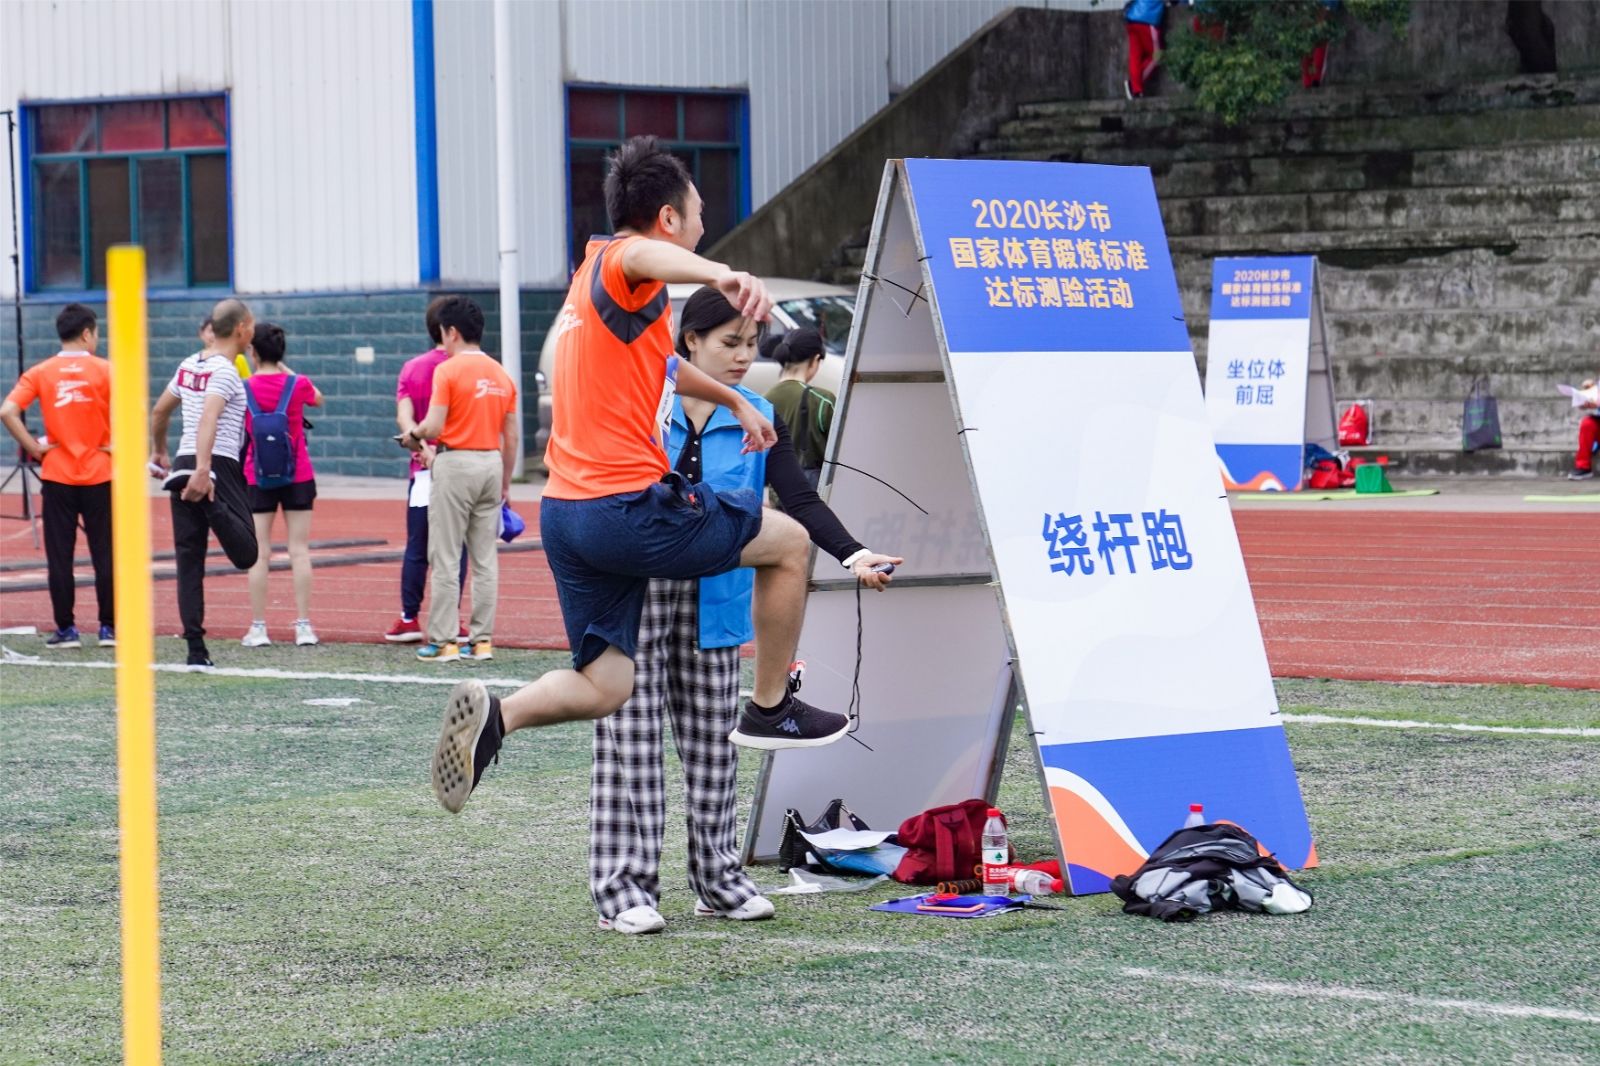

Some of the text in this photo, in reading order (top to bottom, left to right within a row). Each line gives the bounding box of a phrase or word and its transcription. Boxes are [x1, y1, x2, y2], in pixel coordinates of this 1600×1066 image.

[971, 198, 1112, 232] 2020长沙市
[948, 237, 1149, 271] 国家体育锻炼标准
[984, 276, 1135, 309] 达标测验活动
[1226, 358, 1286, 380] 坐位体
[1235, 384, 1274, 406] 前屈
[1042, 508, 1193, 577] 绕杆跑
